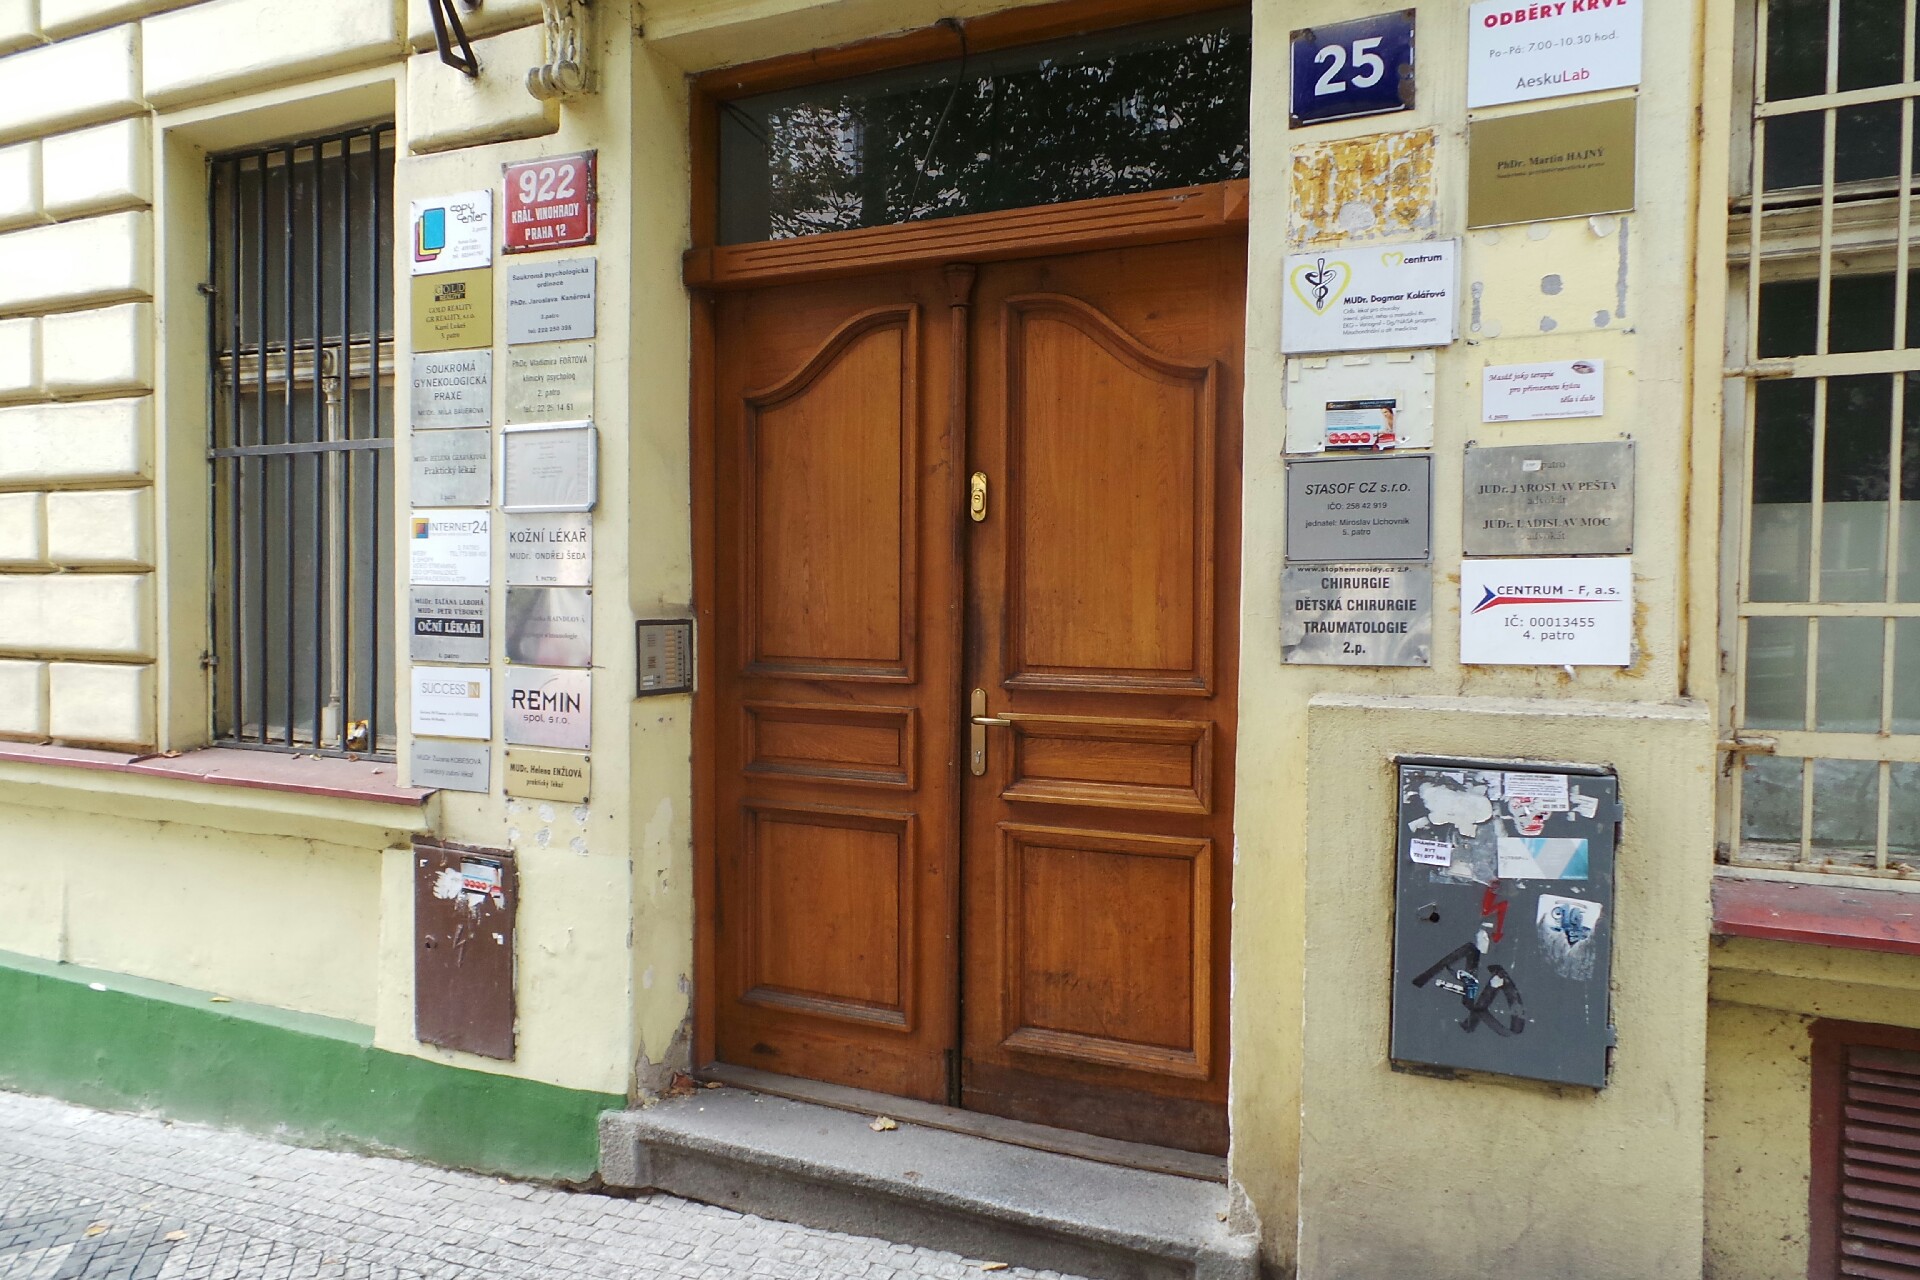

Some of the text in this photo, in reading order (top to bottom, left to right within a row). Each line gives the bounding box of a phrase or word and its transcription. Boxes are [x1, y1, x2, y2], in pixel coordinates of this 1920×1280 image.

[1484, 2, 1565, 28] ODBĚRY
[1594, 30, 1619, 41] hod.
[1314, 36, 1384, 96] 25
[1516, 68, 1590, 89] AeskuLab
[1497, 145, 1605, 170] PhDr. Martin HAJNÝ
[519, 164, 576, 204] 922
[512, 202, 580, 224] KRÁL. VINOHRADY
[525, 224, 567, 241] PRAHA 12
[1404, 254, 1442, 264] centrum
[512, 266, 589, 281] Soukromá psychologická
[435, 282, 466, 294] GOLD
[537, 280, 564, 288] ordinace
[528, 297, 558, 305] Jaroslava
[1344, 296, 1368, 305] MUDr.
[1371, 294, 1405, 304] Dagmar
[448, 304, 472, 312] REALITY
[426, 360, 476, 374] SOUKROMÁ
[414, 373, 487, 388] GYNEKOLOGICKÁ
[546, 373, 576, 382] psycholog
[1530, 371, 1555, 380] terapie
[434, 391, 462, 400] PRAXE
[545, 389, 561, 398] patro
[1509, 384, 1559, 395] pro přirozenou
[557, 403, 564, 411] 14
[424, 466, 456, 475] Praktický
[1305, 482, 1411, 495] STASOF CZ s.r.o.
[1478, 480, 1617, 494] JUDr. JAROSLAV PEŠTA
[430, 520, 488, 534] INTERNET24
[1305, 520, 1337, 528] jednatel:
[1483, 518, 1611, 529] JUDr. LADISLAV MOC
[510, 528, 587, 542] KOŽNÍ LÉKAŘ
[510, 550, 586, 560] MUDr. ONDŘEJ ŠEDA
[1321, 578, 1390, 589] CHIRURGIE
[1497, 586, 1563, 595] CENTRUM
[1579, 586, 1590, 596] F,
[1595, 586, 1620, 595] a.s.
[1296, 596, 1417, 611] DĚTSKÁ CHIRURGIE
[418, 620, 481, 634] OČNÍ LÉKAŘI
[1505, 615, 1595, 627] IČ: 00013455
[1304, 621, 1408, 634] TRAUMATOLOGIE
[1522, 631, 1575, 641] 4. patro
[1343, 642, 1366, 655] 2.p.
[422, 682, 466, 695] SUCCESS
[512, 689, 580, 713] REMIN
[523, 714, 545, 723] spol.
[510, 764, 582, 778] MUDr. Helena ENŽLOVÁ
[526, 779, 549, 788] praktický
